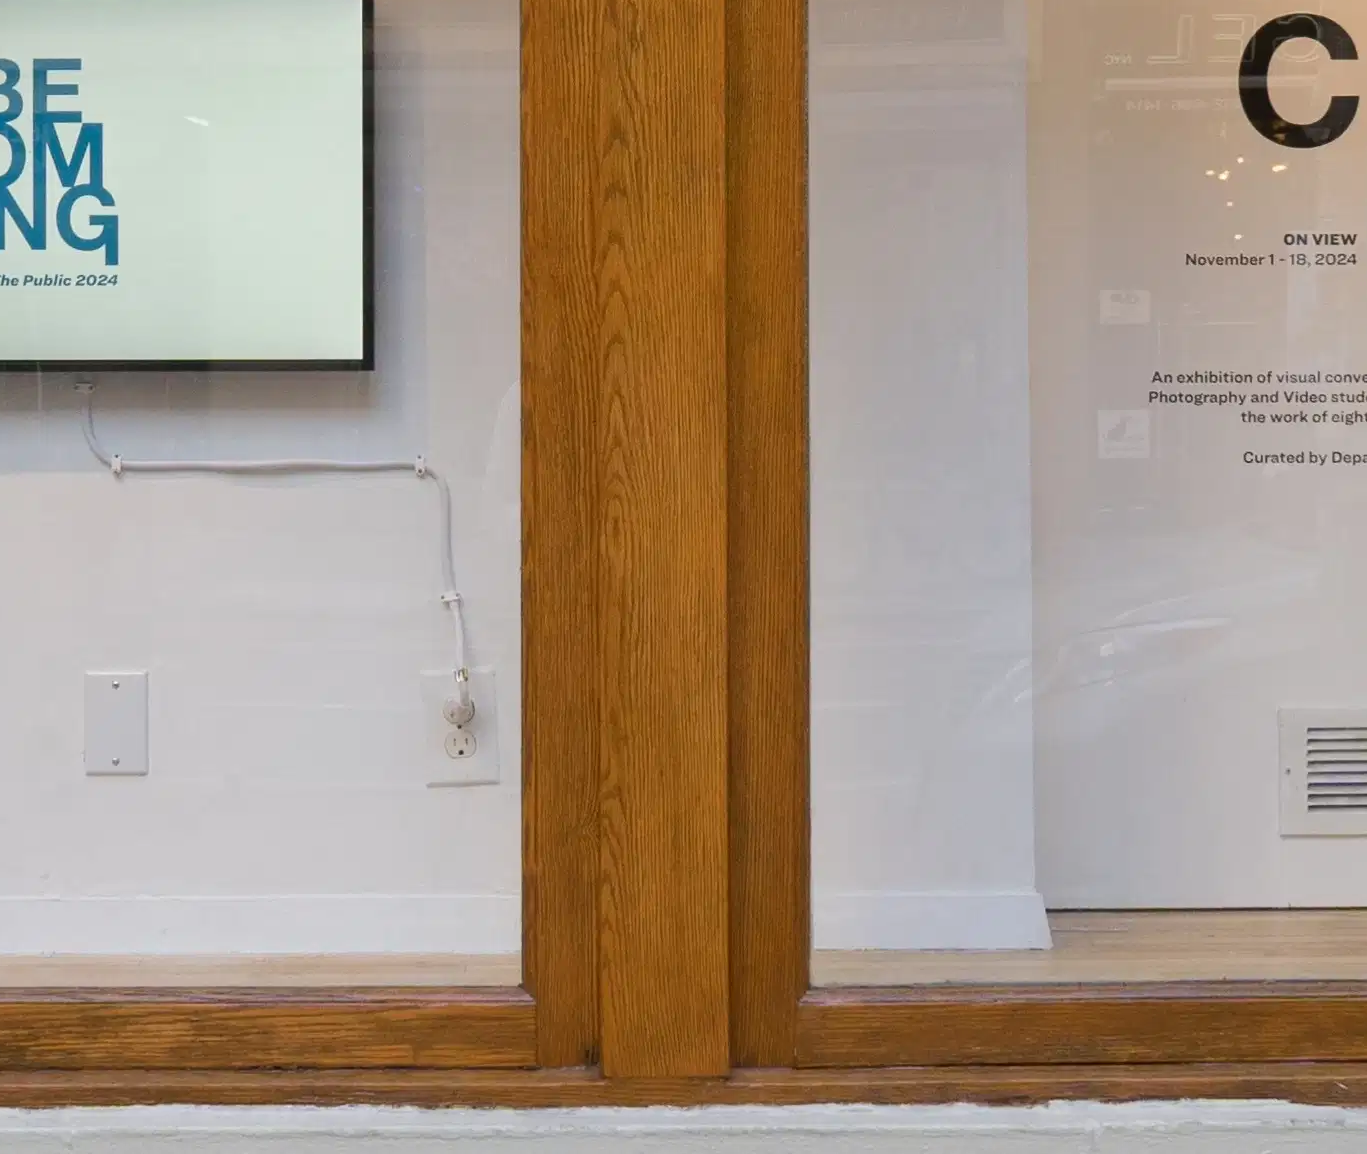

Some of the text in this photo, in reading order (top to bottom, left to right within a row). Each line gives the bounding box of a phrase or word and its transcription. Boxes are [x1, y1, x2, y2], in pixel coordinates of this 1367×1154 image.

[1283, 233, 1358, 246] ON VIEW
[1185, 253, 1266, 266] November
[1269, 253, 1275, 266] 1
[1288, 253, 1311, 268] 18,
[1314, 253, 1357, 266] 2024
[22, 273, 72, 287] Public
[74, 274, 118, 287] 2024
[1151, 370, 1173, 384] An
[1176, 370, 1254, 384] exhibition
[1256, 370, 1273, 384] of
[1275, 370, 1321, 384] visual
[1148, 390, 1247, 407] Photography
[1250, 390, 1279, 404] and
[1283, 390, 1328, 404] Video
[1240, 410, 1266, 424] the
[1269, 410, 1309, 424] work
[1311, 410, 1328, 424] of
[1243, 451, 1305, 464] Curated
[1308, 450, 1328, 466] by
